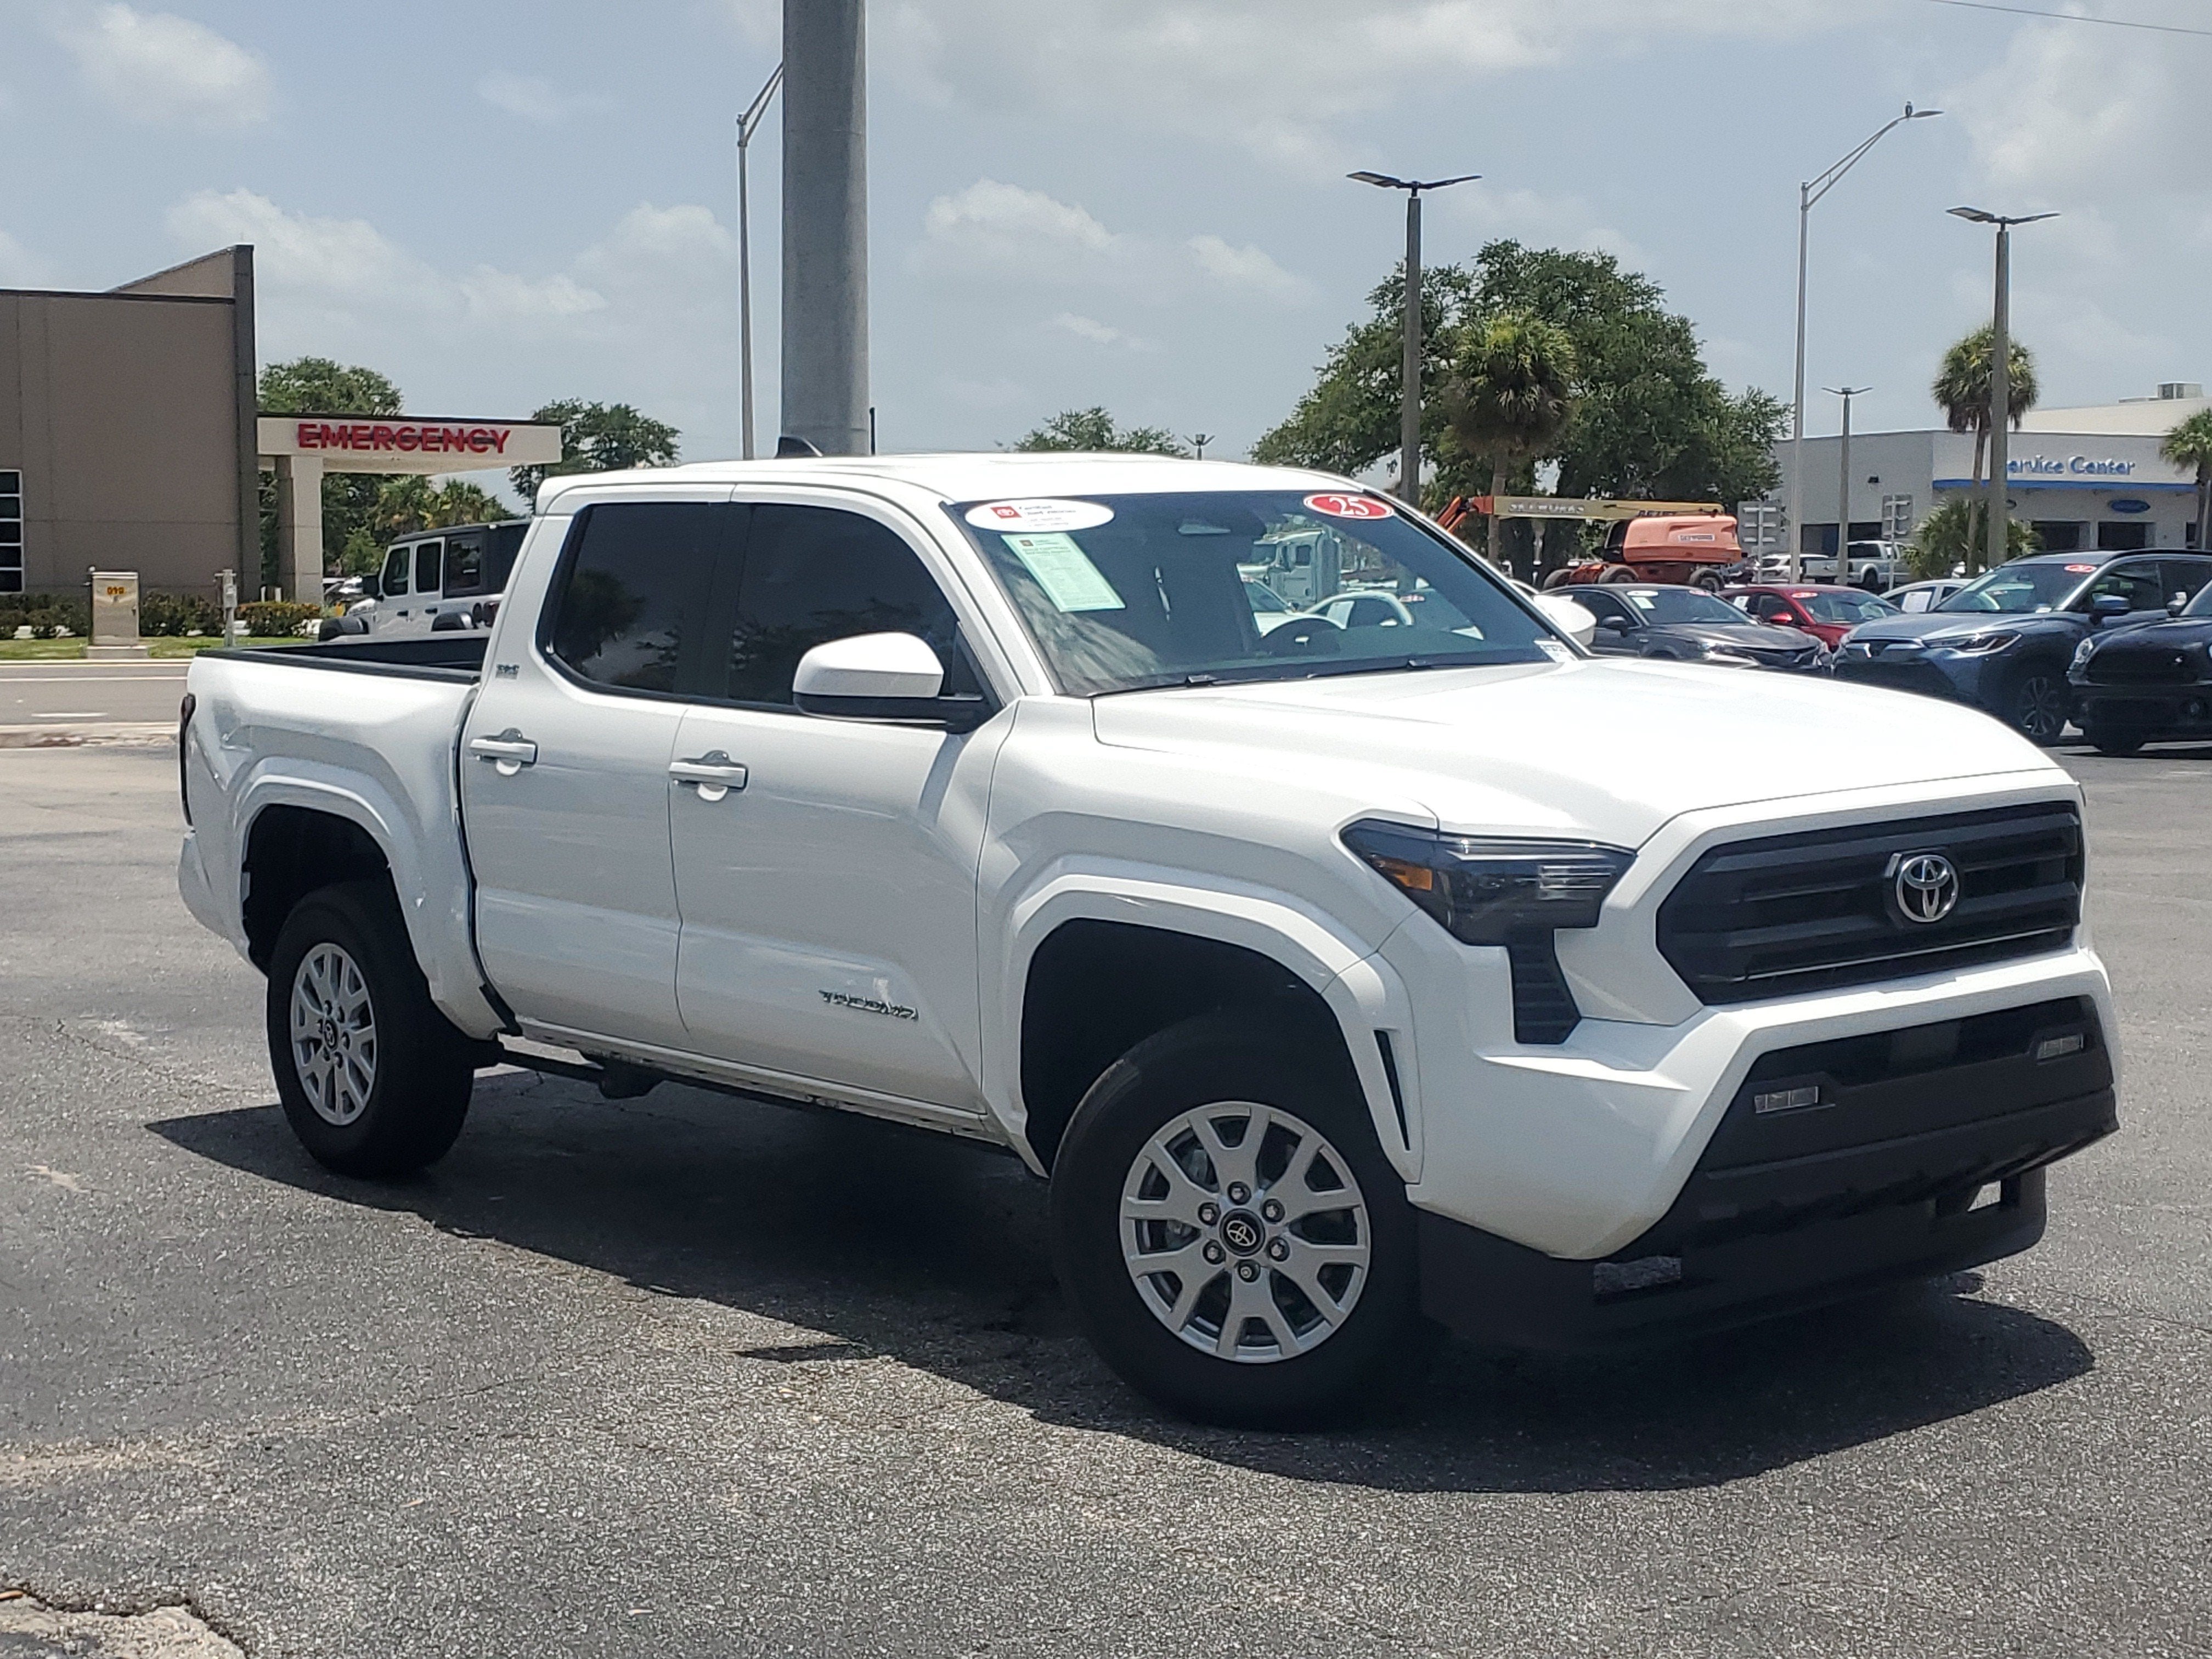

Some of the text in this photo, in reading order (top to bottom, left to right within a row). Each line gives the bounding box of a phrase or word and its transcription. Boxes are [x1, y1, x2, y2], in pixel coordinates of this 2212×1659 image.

[297, 424, 511, 454] EMERGENCY
[2007, 454, 2135, 475] ervice Center
[1329, 496, 1369, 516] 25
